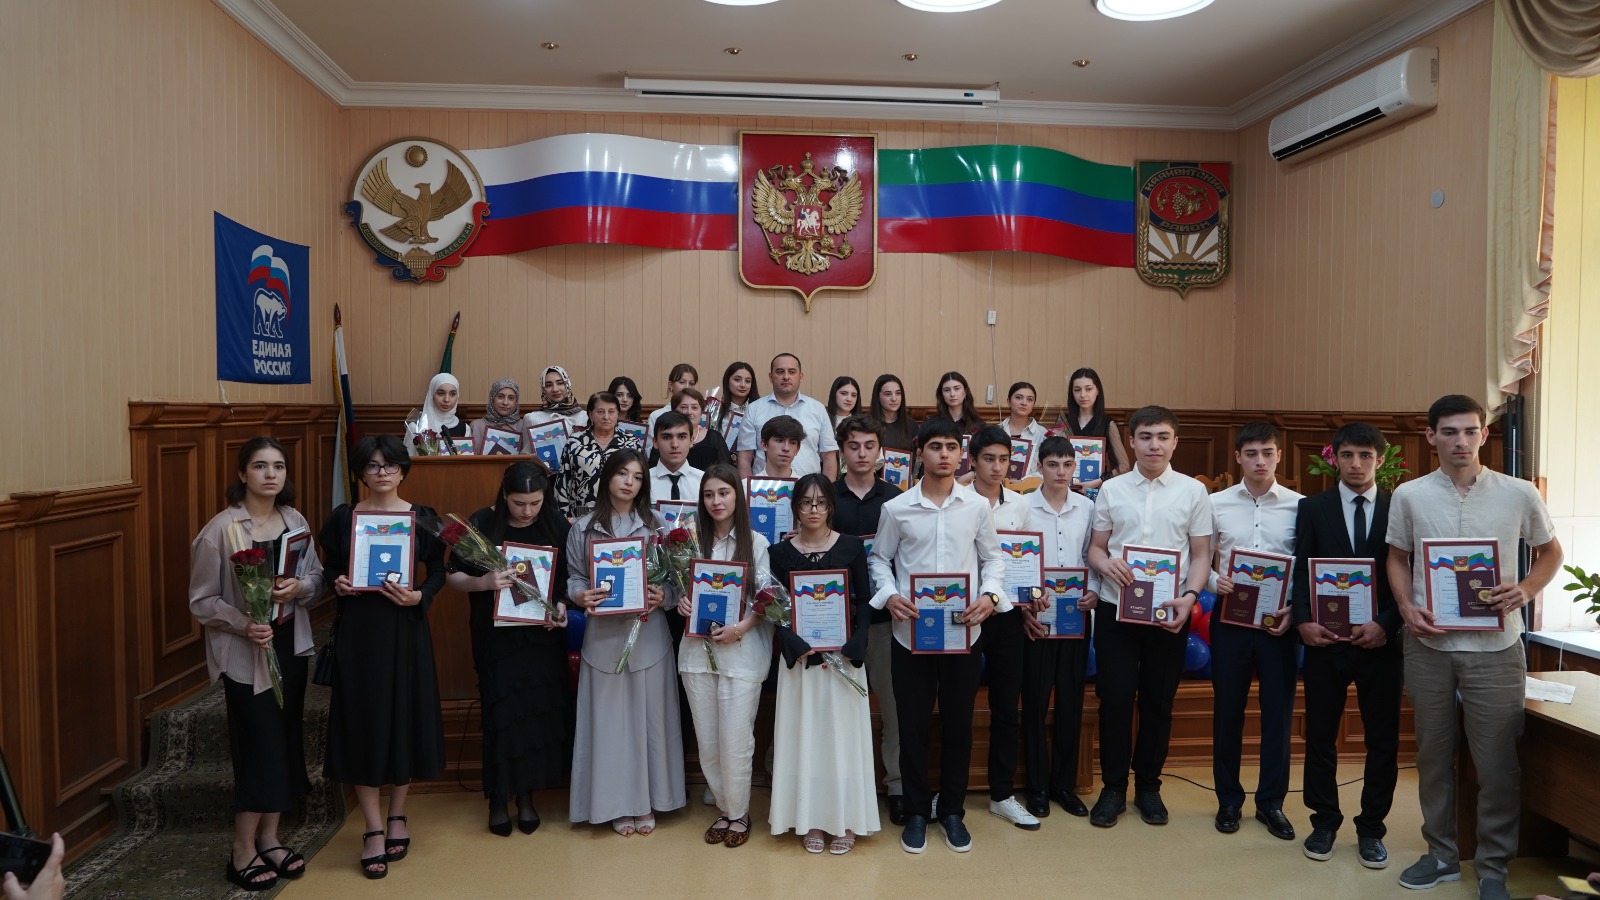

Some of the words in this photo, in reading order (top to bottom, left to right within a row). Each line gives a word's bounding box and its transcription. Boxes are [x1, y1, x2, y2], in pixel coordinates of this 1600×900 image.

[361, 222, 399, 260] РЕСПУБЛИКА
[437, 222, 474, 260] ДАГЕСТАН
[252, 339, 292, 358] ЕДИНАЯ
[253, 358, 292, 376] РОССИЯ
